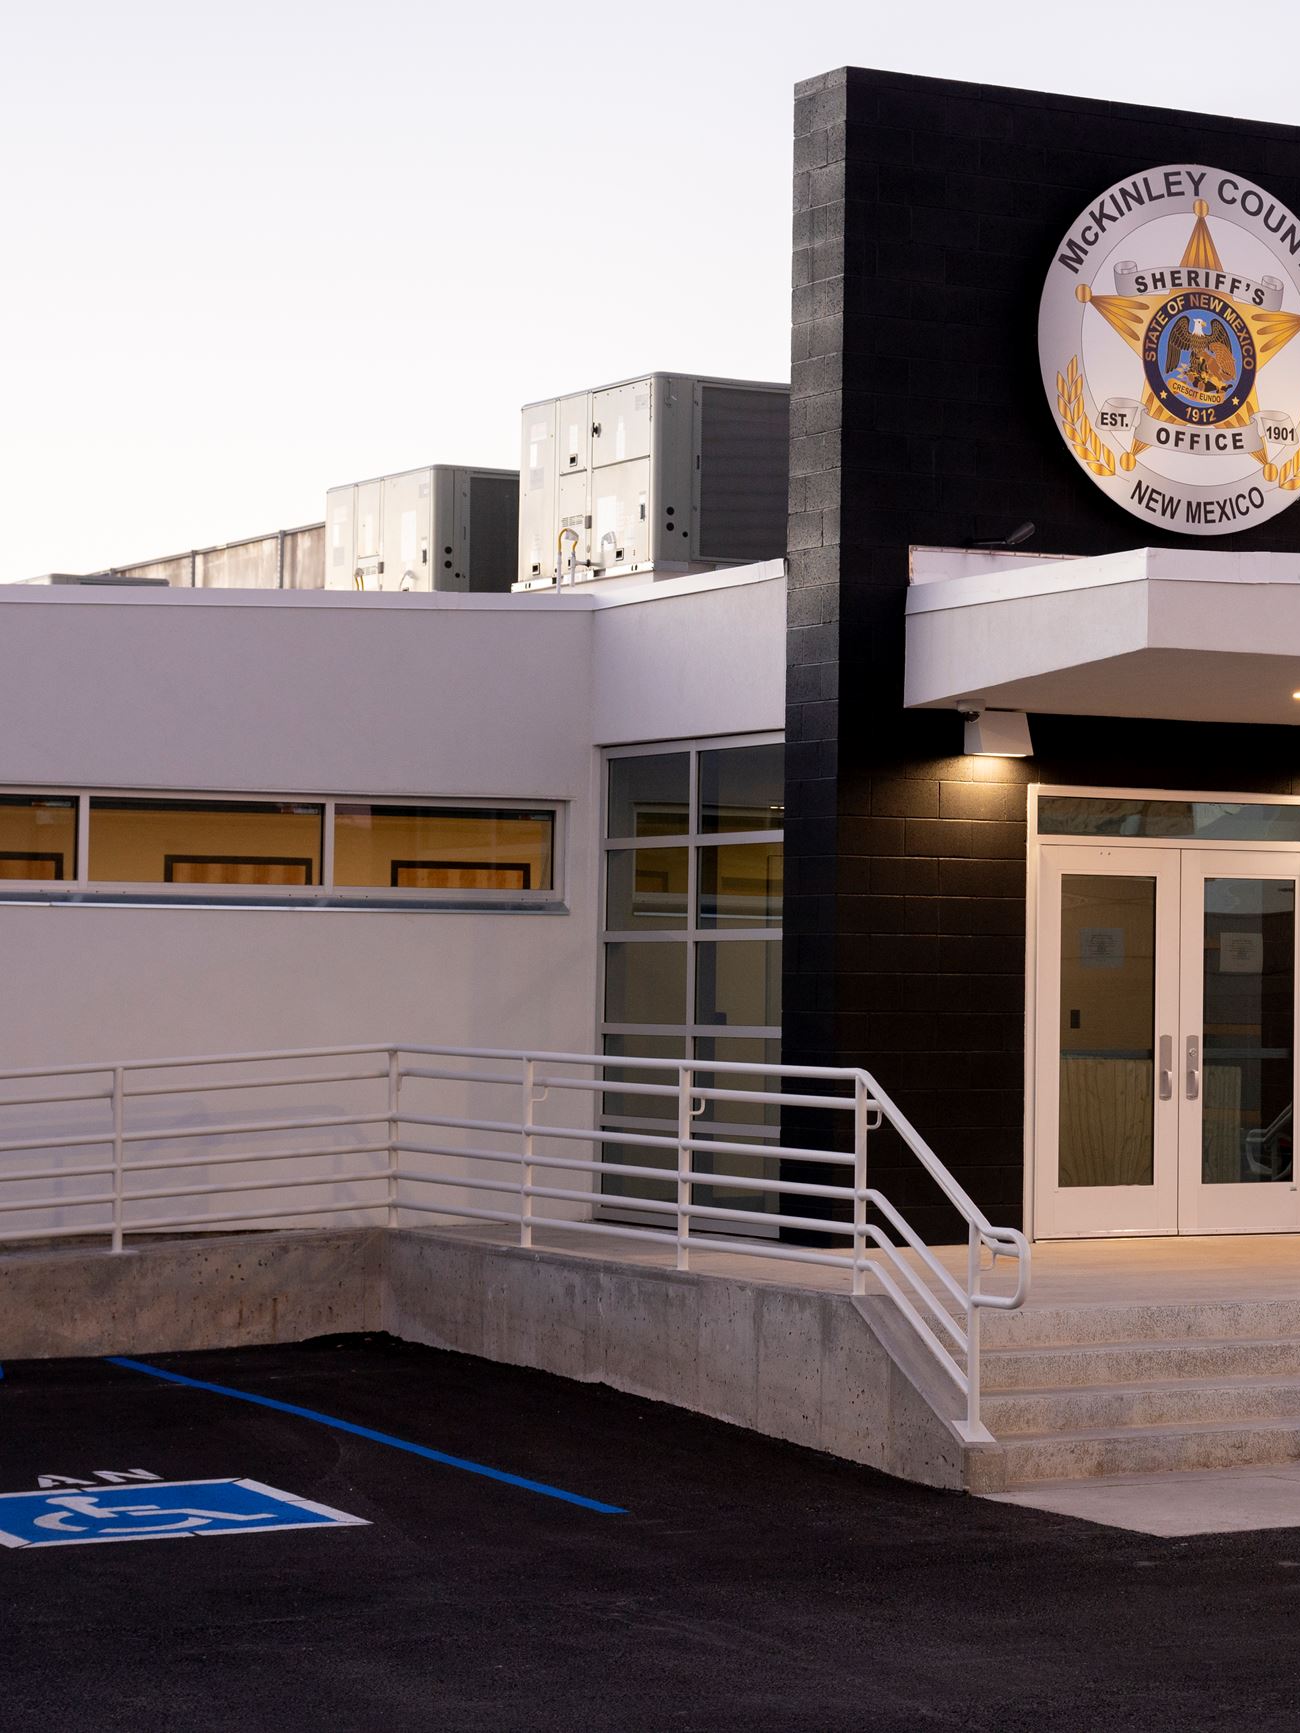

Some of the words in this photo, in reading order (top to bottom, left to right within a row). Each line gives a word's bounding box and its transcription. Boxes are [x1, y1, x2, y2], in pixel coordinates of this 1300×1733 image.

[1058, 171, 1207, 274] McKINLEY
[1134, 270, 1265, 306] SHERIFF'S
[1145, 311, 1168, 361] STATE
[1167, 296, 1185, 315] OF
[1190, 294, 1223, 313] NEW
[1223, 308, 1254, 370] MEXICO
[1172, 382, 1198, 398] CRESCIT
[1199, 393, 1221, 403] EUNDO
[1100, 411, 1129, 428] EST.
[1185, 407, 1217, 423] 1912
[1156, 427, 1244, 451] OFFICE
[1266, 426, 1296, 442] 1901
[1130, 480, 1181, 519] NEW
[1185, 486, 1265, 524] MEXICO
